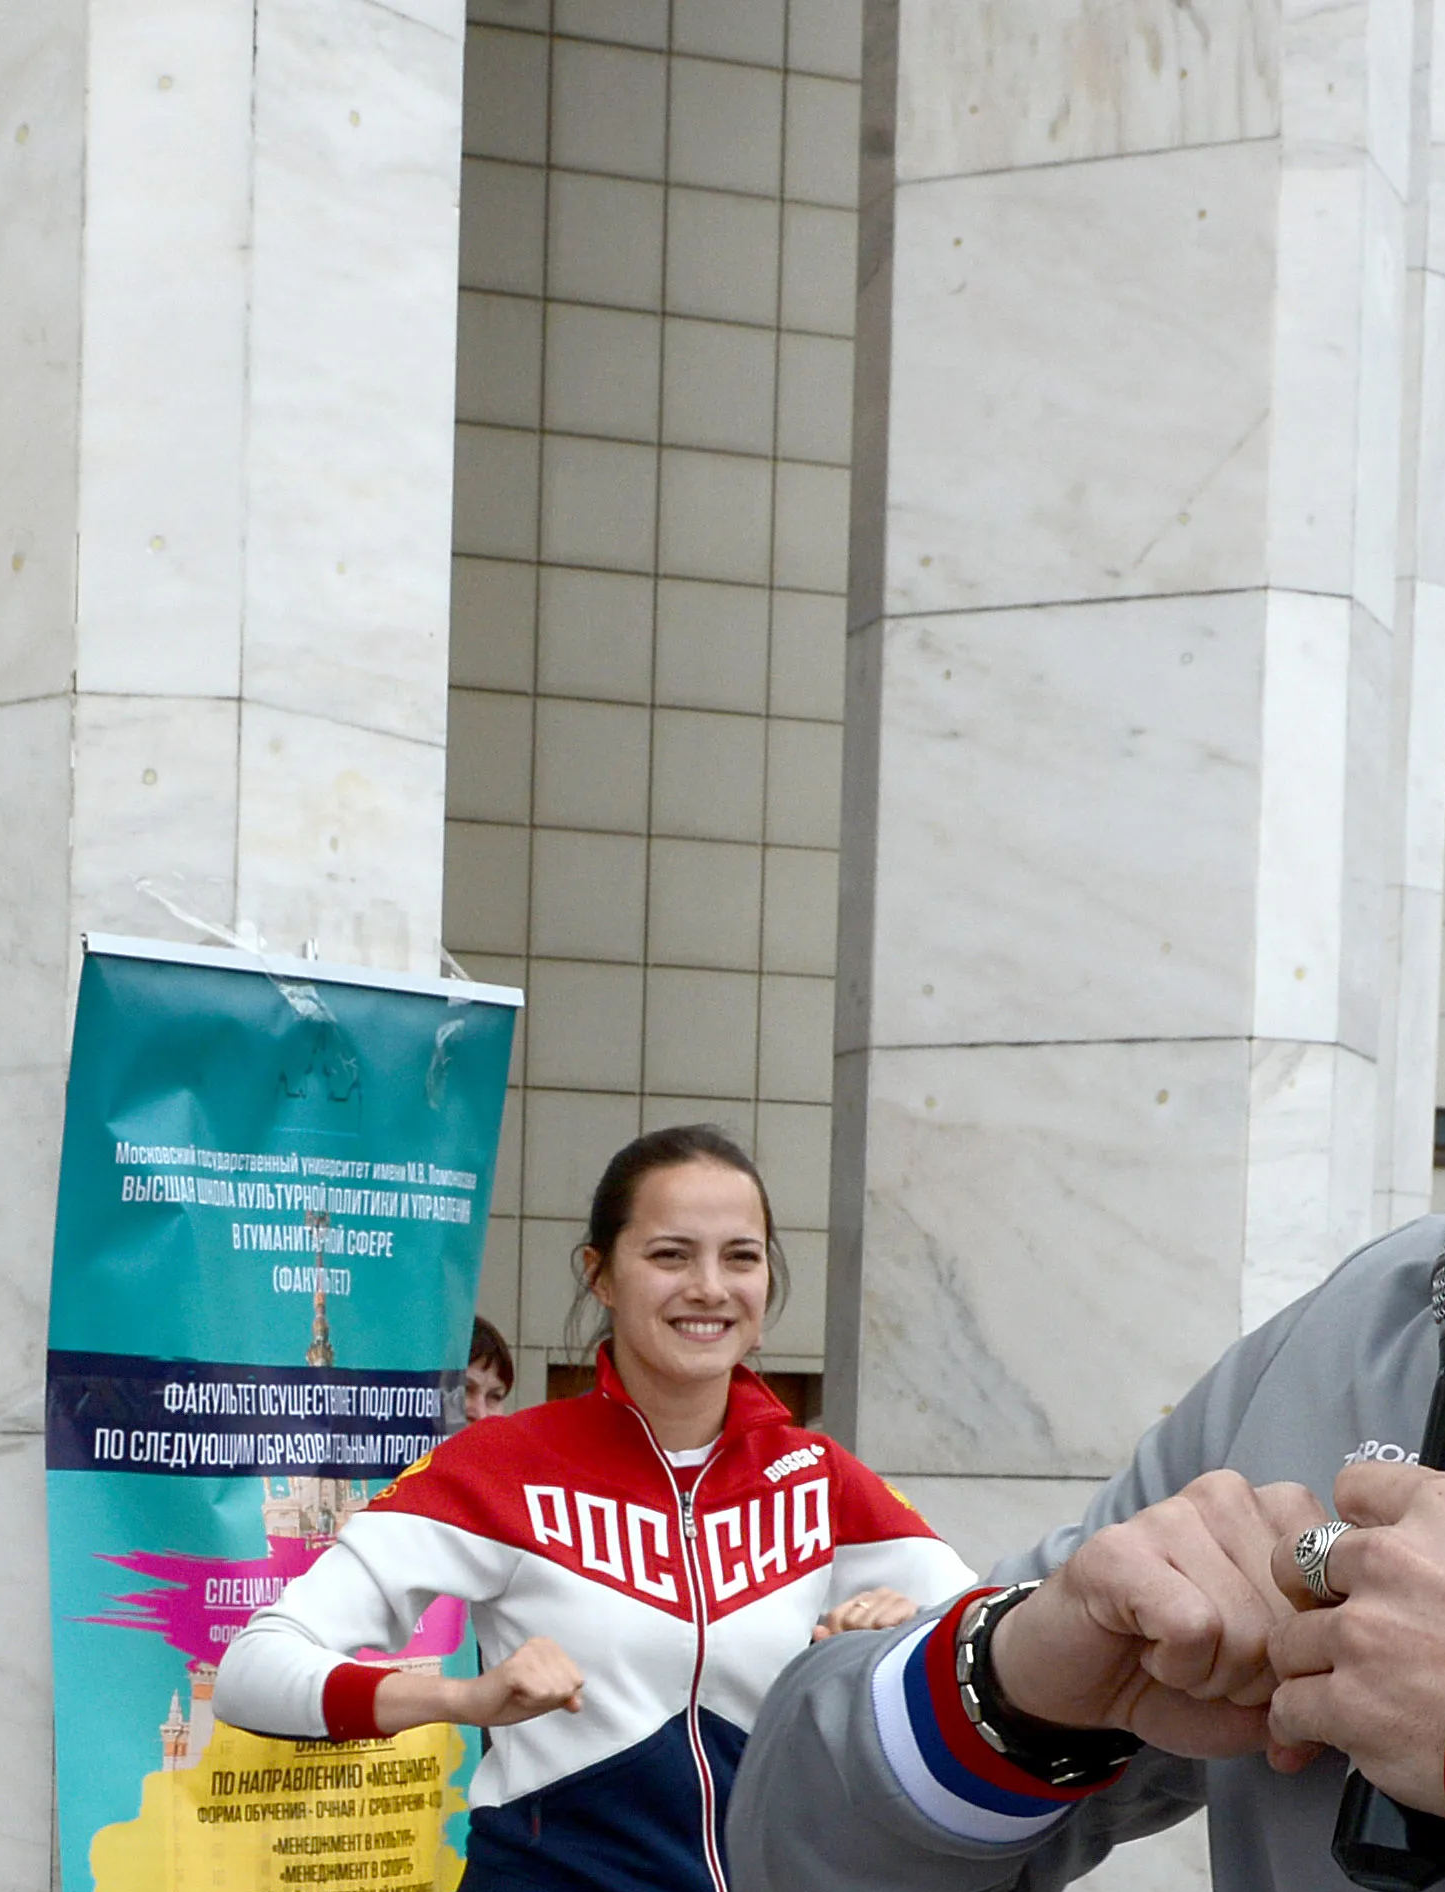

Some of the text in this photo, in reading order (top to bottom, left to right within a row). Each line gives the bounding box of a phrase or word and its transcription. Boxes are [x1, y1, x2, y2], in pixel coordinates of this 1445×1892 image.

[115, 1141, 196, 1167] Московский
[121, 1175, 196, 1203] ВЫСШАЯ
[196, 1177, 236, 1207] ШКОЛА
[237, 1182, 326, 1212] КУЛЬТУРНОЙ
[328, 1187, 398, 1217] ПОЛИТИКИ
[400, 1192, 409, 1218] И
[232, 1223, 395, 1258] В ГУМАНИТАРНОЙ СФЕРЕ
[164, 1381, 256, 1416] ФАКУЛЬТЕТ
[95, 1428, 124, 1460] ПО
[130, 1431, 255, 1468] СЛЕДУЮЩИМ
[211, 1770, 235, 1797] ПО
[238, 1763, 363, 1795] НАПРАВЛЕНИЮ
[197, 1806, 242, 1824] ФОРМА
[245, 1802, 306, 1822] ОБУЧЕНИЯ
[316, 1799, 355, 1819] ОЧНАЯ
[272, 1833, 362, 1855] «МЕНЕДЖМЕНТ
[365, 1833, 372, 1851] В
[279, 1862, 368, 1883] «МЕНЕДЖМЕНТ
[371, 1860, 378, 1878] В
